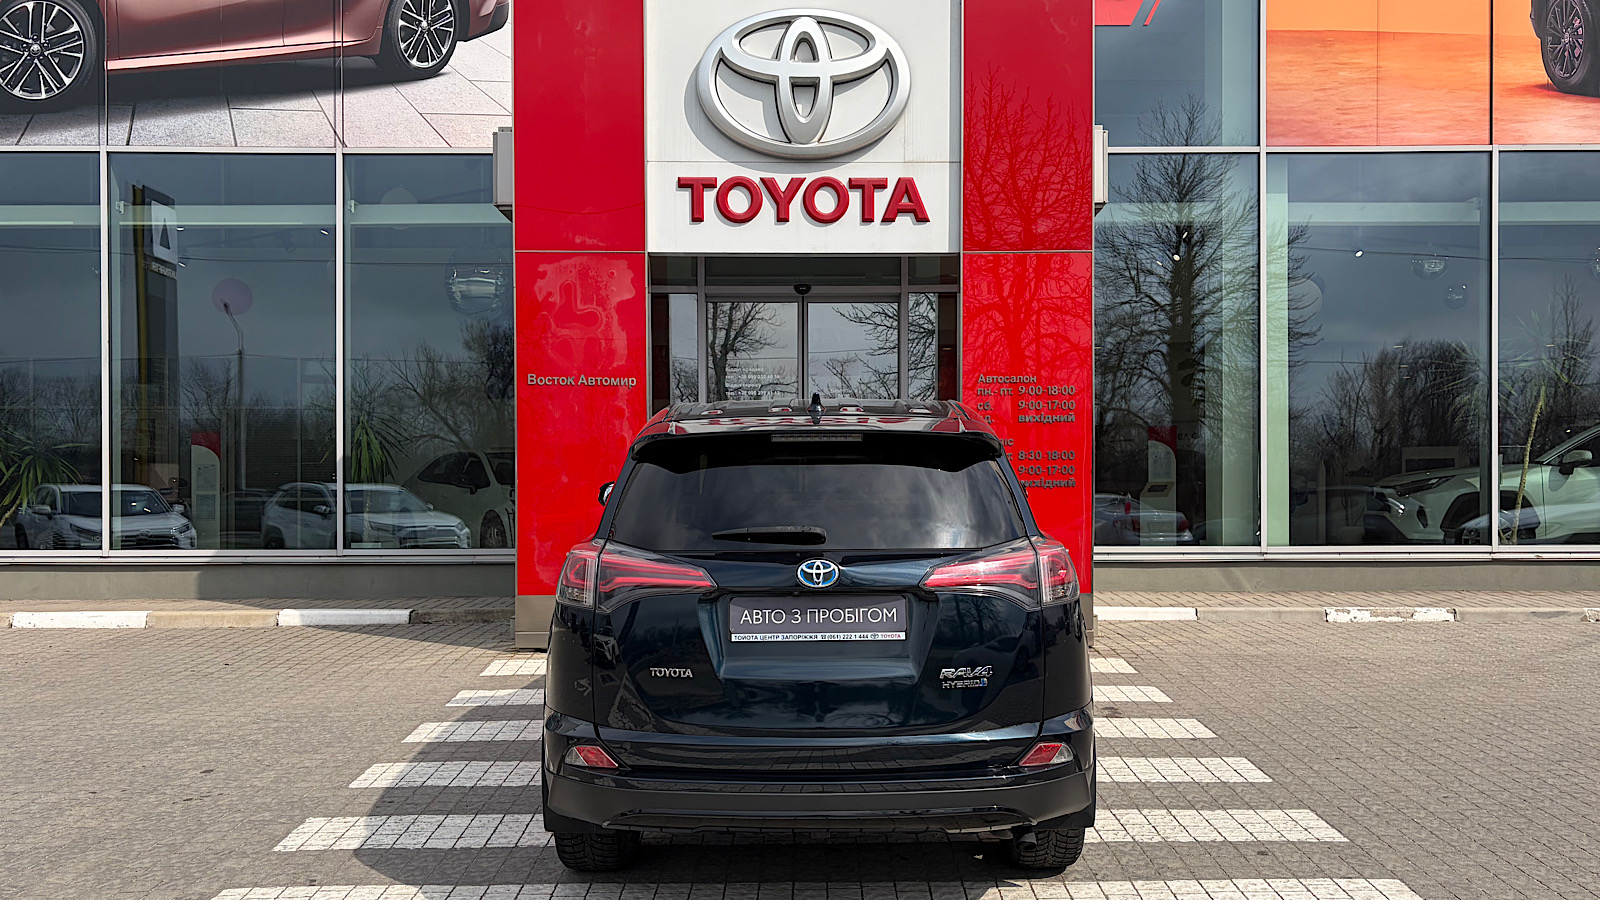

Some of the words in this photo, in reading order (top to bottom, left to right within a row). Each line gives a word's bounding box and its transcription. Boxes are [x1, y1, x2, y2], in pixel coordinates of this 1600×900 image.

[677, 175, 931, 223] TOYOTA
[527, 373, 576, 386] Восток
[578, 374, 637, 389] Автомир
[977, 373, 1037, 383] Автосалон
[1018, 385, 1076, 396] 9:00-18:00
[977, 401, 994, 411] сб.
[1018, 400, 1076, 411] 9:00-17:00
[1018, 412, 1076, 424] вихідний
[1018, 450, 1076, 461] 8:30-18:00
[1018, 465, 1076, 476] 9:00-17:00
[740, 609, 786, 625] АВТО
[806, 607, 897, 624] ПРОБІГОМ
[649, 667, 693, 678] TOYOTA
[939, 665, 993, 679] RAV4
[942, 679, 981, 689] HYBRID
